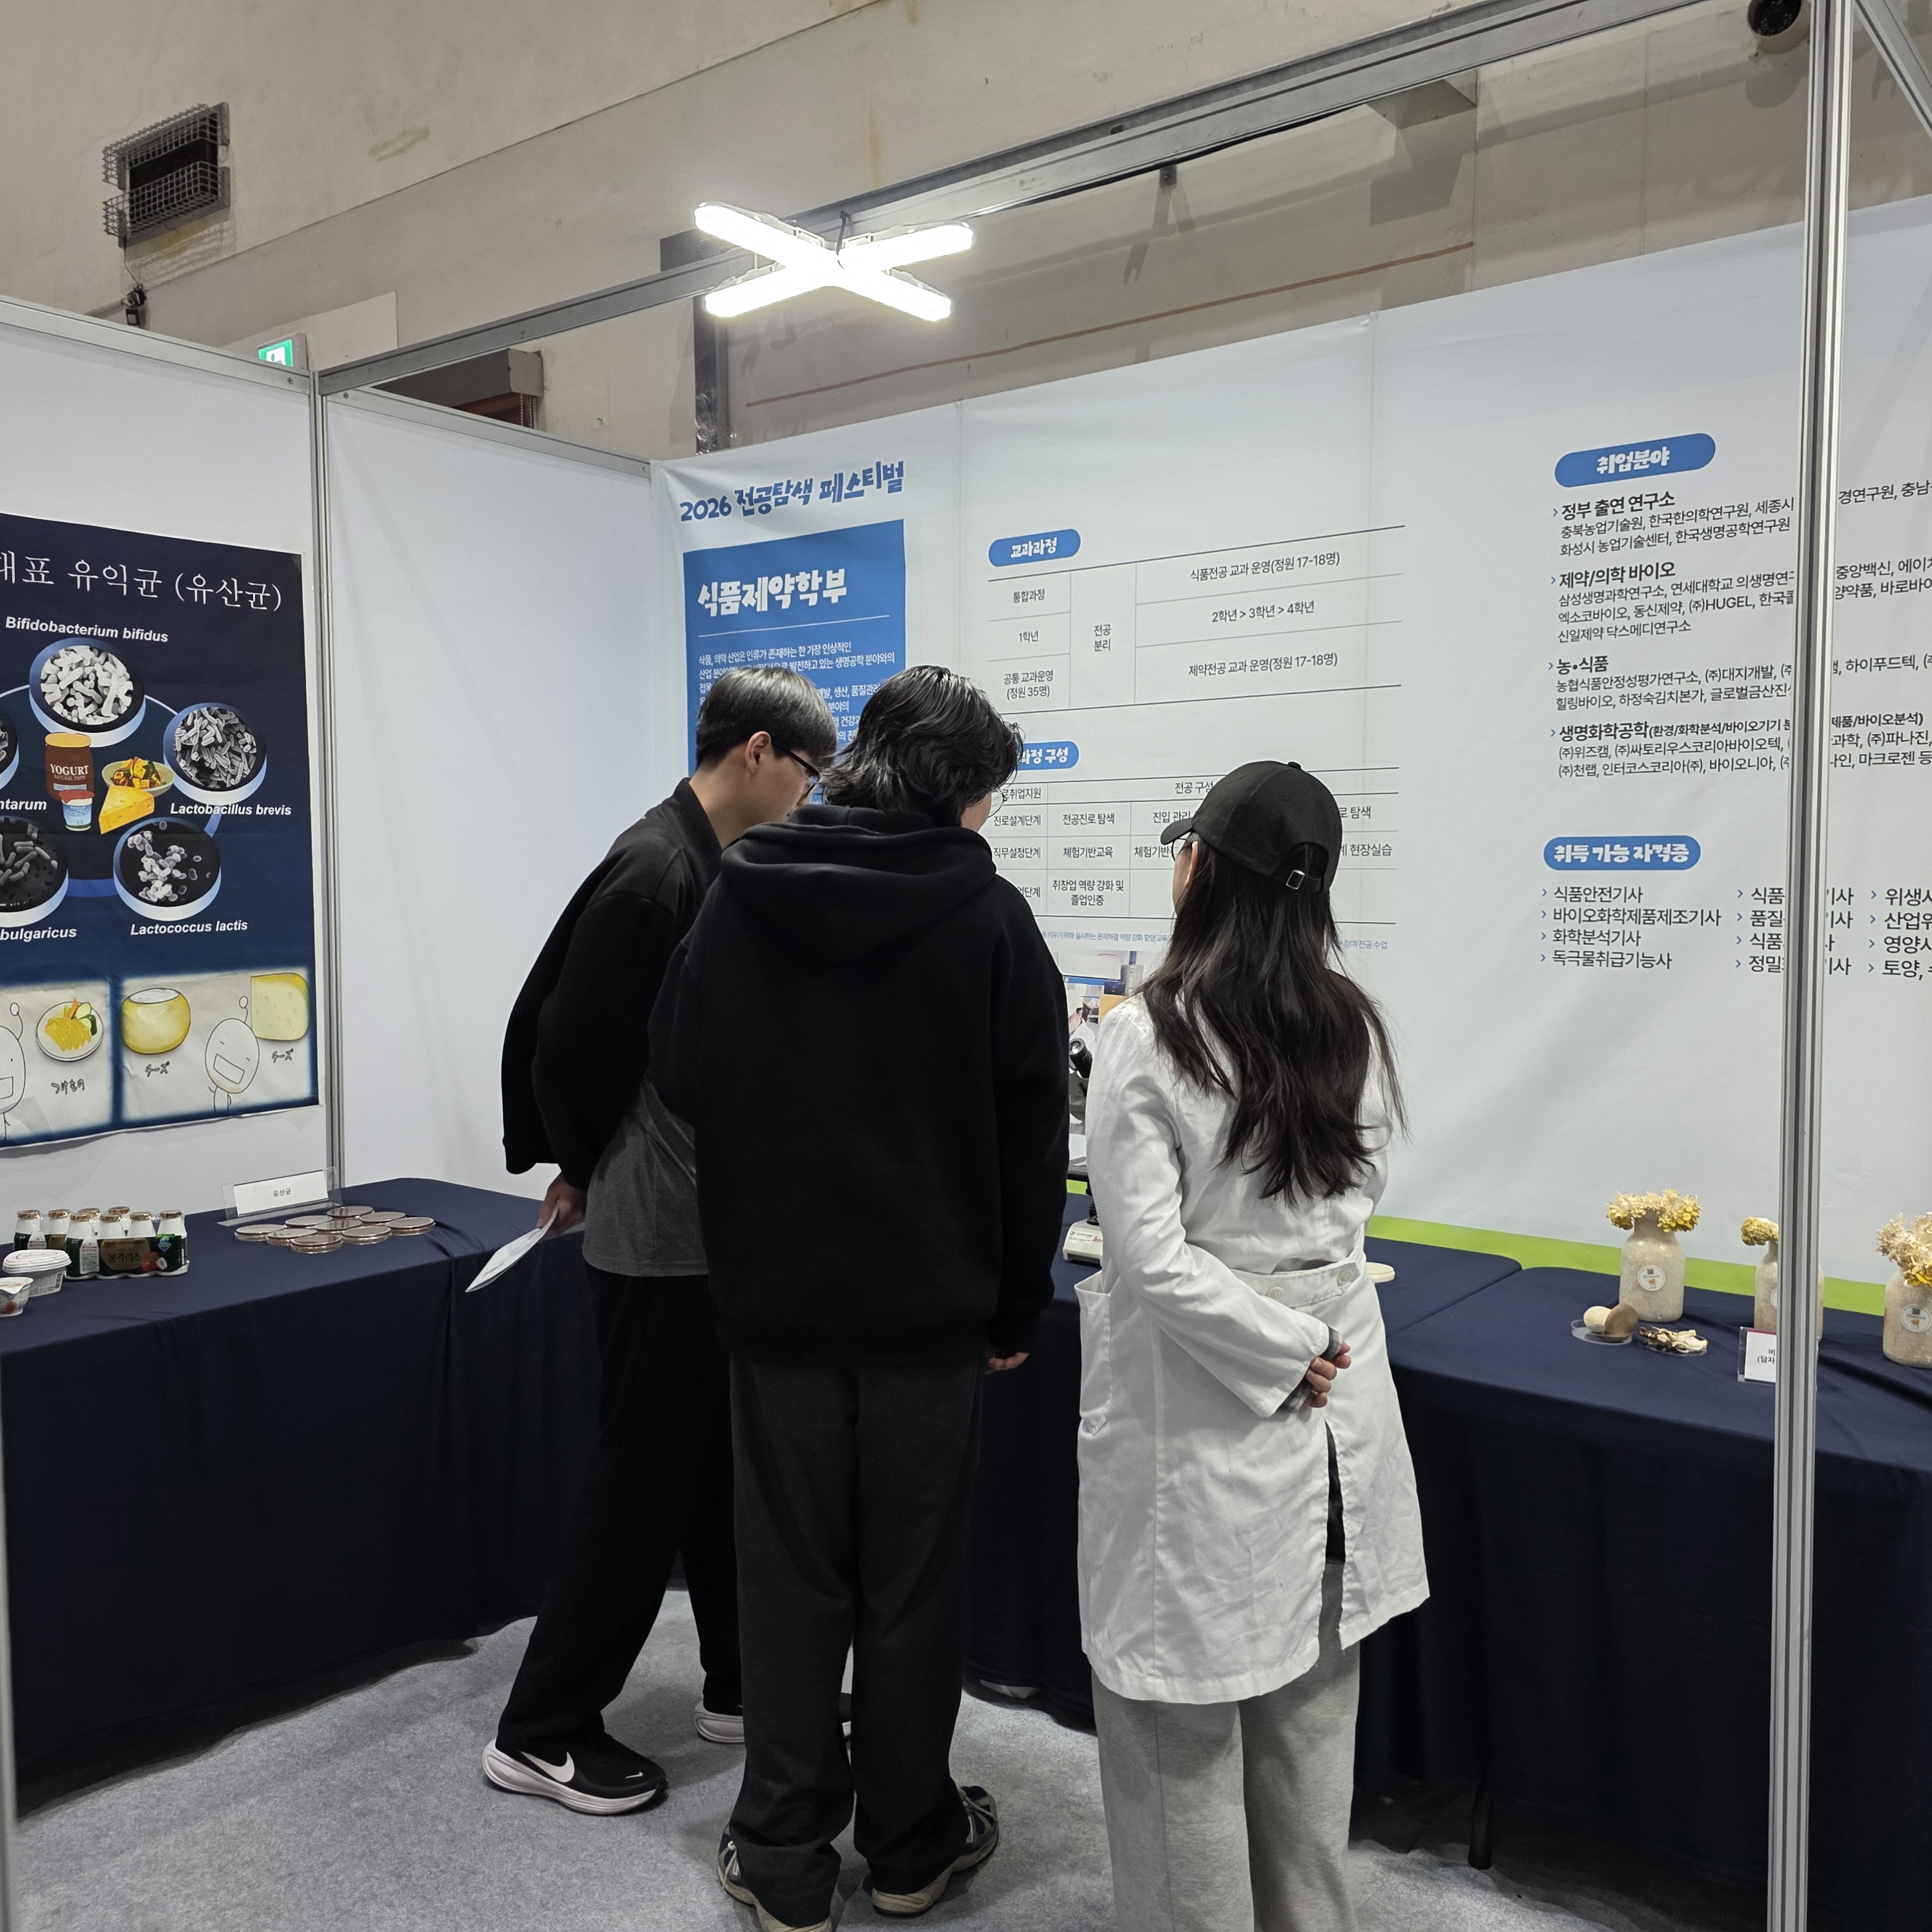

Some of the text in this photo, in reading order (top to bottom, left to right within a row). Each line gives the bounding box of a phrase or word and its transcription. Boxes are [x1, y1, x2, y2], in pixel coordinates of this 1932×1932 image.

[1596, 446, 1670, 475] 취업분야
[679, 460, 904, 522] 2026 전공탐색 페스티벌
[1561, 491, 1675, 521] 정부 출연 연구소
[1561, 516, 1646, 539] 충북농업기술원,
[1648, 502, 1752, 528] 한국한의학연구원,
[1900, 480, 1932, 497] 충남
[1559, 517, 1791, 557] 화성시 농업기술센터, 한국생명공학연구원
[1011, 537, 1057, 559] 교과과정
[1190, 551, 1340, 582] 식품전공 교과 운영(정원 17-18명)
[1559, 562, 1676, 588] 제약/의학 바이오
[67, 559, 162, 597] 유익균
[175, 573, 282, 611] (유산균)
[697, 568, 847, 617] 식품제약학부
[1559, 584, 1667, 607] 삼성생명과학연구소,
[1670, 578, 1733, 597] 연세대학교
[1012, 588, 1045, 603] 통합과정
[1212, 601, 1315, 623] 2학년 3학년 4학년
[1558, 606, 1630, 625] 엑소코바이오,
[1633, 601, 1685, 618] 동신제약,
[5, 617, 169, 642] Bifidobacterium bifidus
[1018, 630, 1039, 642] 1학년
[1094, 624, 1111, 637] 전공
[1558, 619, 1691, 643] 신일제약 닥스메디연구소
[714, 653, 727, 664] 의약
[728, 652, 746, 663] 산업은
[746, 649, 767, 662] 인류가
[768, 646, 797, 660] 존재하는
[798, 645, 807, 657] 한
[807, 644, 821, 656] 가장
[822, 641, 852, 655] 인상적인
[1094, 639, 1111, 652] 분리
[699, 669, 712, 680] 산업
[819, 658, 834, 670] 있는
[835, 655, 865, 668] 생명공학
[865, 652, 895, 666] 분야와의
[1189, 652, 1338, 677] 제약전공 교과 운영(정원 17-18명)
[1845, 654, 1919, 673] 하이푸드텍,
[1003, 670, 1054, 685] 공통 교과운영
[1007, 684, 1051, 701] (정원 35명)
[1556, 683, 1791, 711] 힐링바이오, 하정숙김치본가, 글로벌금산진
[1045, 747, 1069, 764] 구성
[1710, 755, 1776, 772] 바이오니아,
[1859, 751, 1915, 767] 마크로젠
[50, 764, 89, 776] YOGURT
[1175, 782, 1193, 794] 전공
[170, 803, 291, 816] Lactobacillus brevis
[993, 814, 1042, 827] 진로설계단계
[1063, 814, 1096, 826] 전공진로
[1097, 812, 1115, 825] 탐색
[1153, 811, 1171, 823] 진입
[1351, 806, 1371, 819] 탐색
[993, 847, 1041, 859] 직무설정단계
[1063, 846, 1113, 858] 체험기반교육
[1350, 843, 1392, 857] 현장실습
[1554, 843, 1689, 863] 취득 가능 자격증
[1052, 879, 1076, 891] 취창업
[1078, 879, 1095, 891] 역량
[1096, 879, 1114, 891] 강화
[1116, 879, 1124, 891] 및
[1553, 886, 1643, 903] 식품안전기사
[1071, 894, 1105, 906] 졸업인증
[1553, 907, 1722, 926] 바이오화학제품제조기사
[0, 927, 77, 942] bulgaricus
[130, 920, 248, 936] Lactococcus lactis
[1552, 928, 1641, 947] 화학분석기사
[1373, 940, 1388, 949] 수업
[1552, 950, 1672, 969] 독극물취급기능사
[272, 1188, 291, 1198] 유산균
